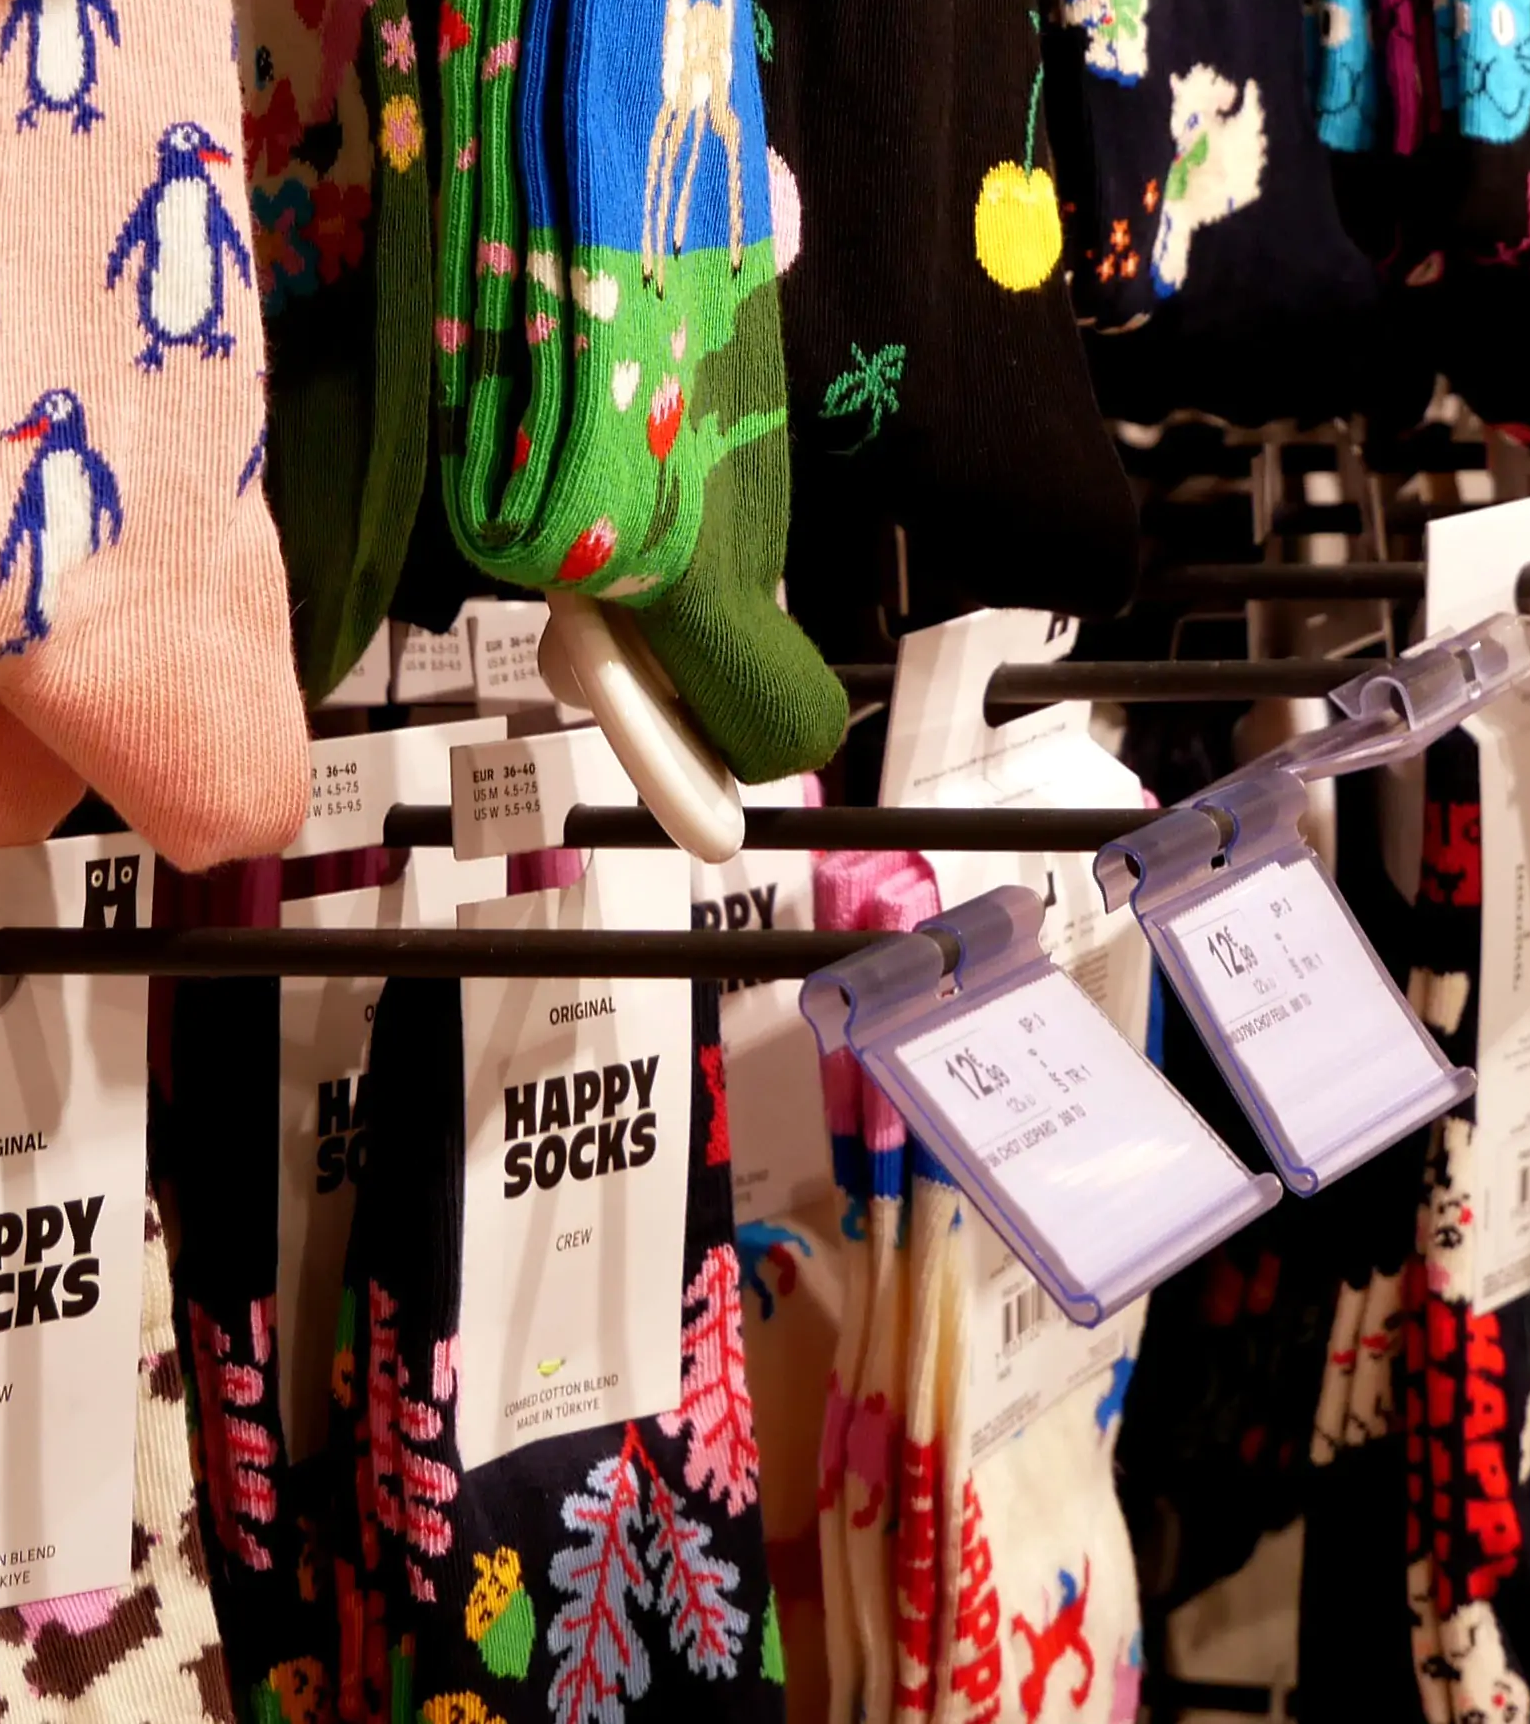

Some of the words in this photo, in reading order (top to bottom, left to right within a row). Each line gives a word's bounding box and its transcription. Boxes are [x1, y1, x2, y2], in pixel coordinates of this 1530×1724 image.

[326, 762, 357, 778] 36-40
[473, 769, 494, 783] EUR
[503, 762, 536, 778] 36-40
[327, 781, 359, 796] 4.5-7.5
[474, 791, 487, 802] US
[489, 788, 498, 799] M
[504, 781, 537, 797] 4.5-7.5
[328, 799, 362, 815] 5.5-9.5
[474, 809, 487, 821] US
[489, 806, 498, 819] W
[505, 799, 540, 816] 5.5-9.5
[549, 997, 616, 1025] ORIGINAL
[504, 1055, 659, 1142] HAPPY
[504, 1112, 657, 1199] SOCKS
[556, 1228, 592, 1252] CREW
[505, 1394, 538, 1418] COMBED
[540, 1382, 581, 1405] COTTON
[584, 1374, 619, 1394] BLEND
[517, 1411, 541, 1431] MADE
[542, 1407, 553, 1422] IN
[10, 1545, 56, 1566] BLEND
